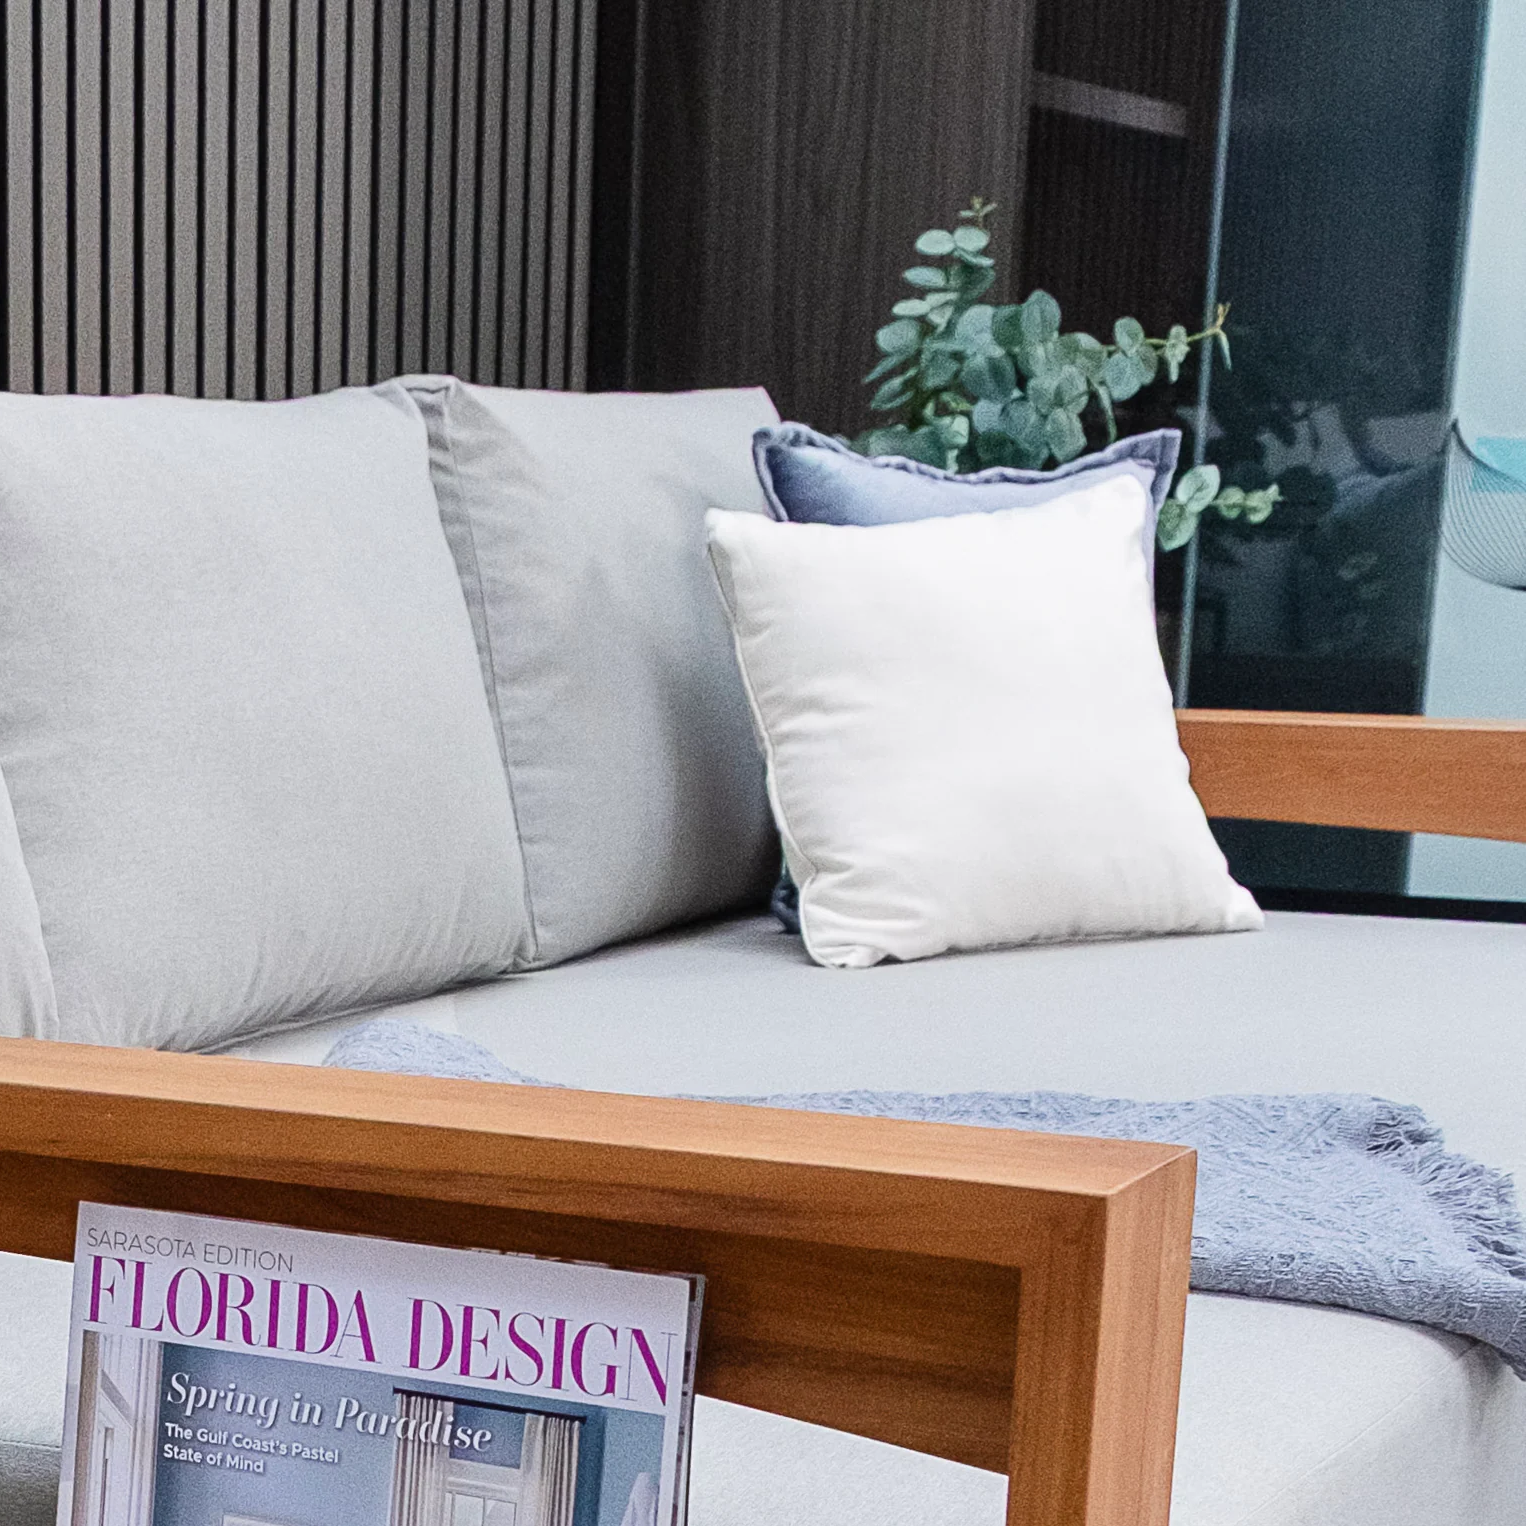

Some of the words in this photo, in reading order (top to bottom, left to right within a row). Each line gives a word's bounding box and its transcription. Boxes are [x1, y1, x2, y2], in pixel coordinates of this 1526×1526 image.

[87, 1228, 196, 1260] SARASOTA
[204, 1243, 293, 1273] EDITION
[84, 1254, 381, 1363] FLORIDA
[402, 1297, 678, 1406] DESIGN
[167, 1372, 279, 1429] Spring
[290, 1392, 322, 1426] in
[335, 1397, 492, 1452] Paradise
[163, 1443, 202, 1463] State
[206, 1451, 223, 1466] of
[226, 1453, 264, 1473] Mind
[165, 1422, 193, 1440] The
[197, 1427, 228, 1445] Gulf
[291, 1442, 339, 1463] Pastel
